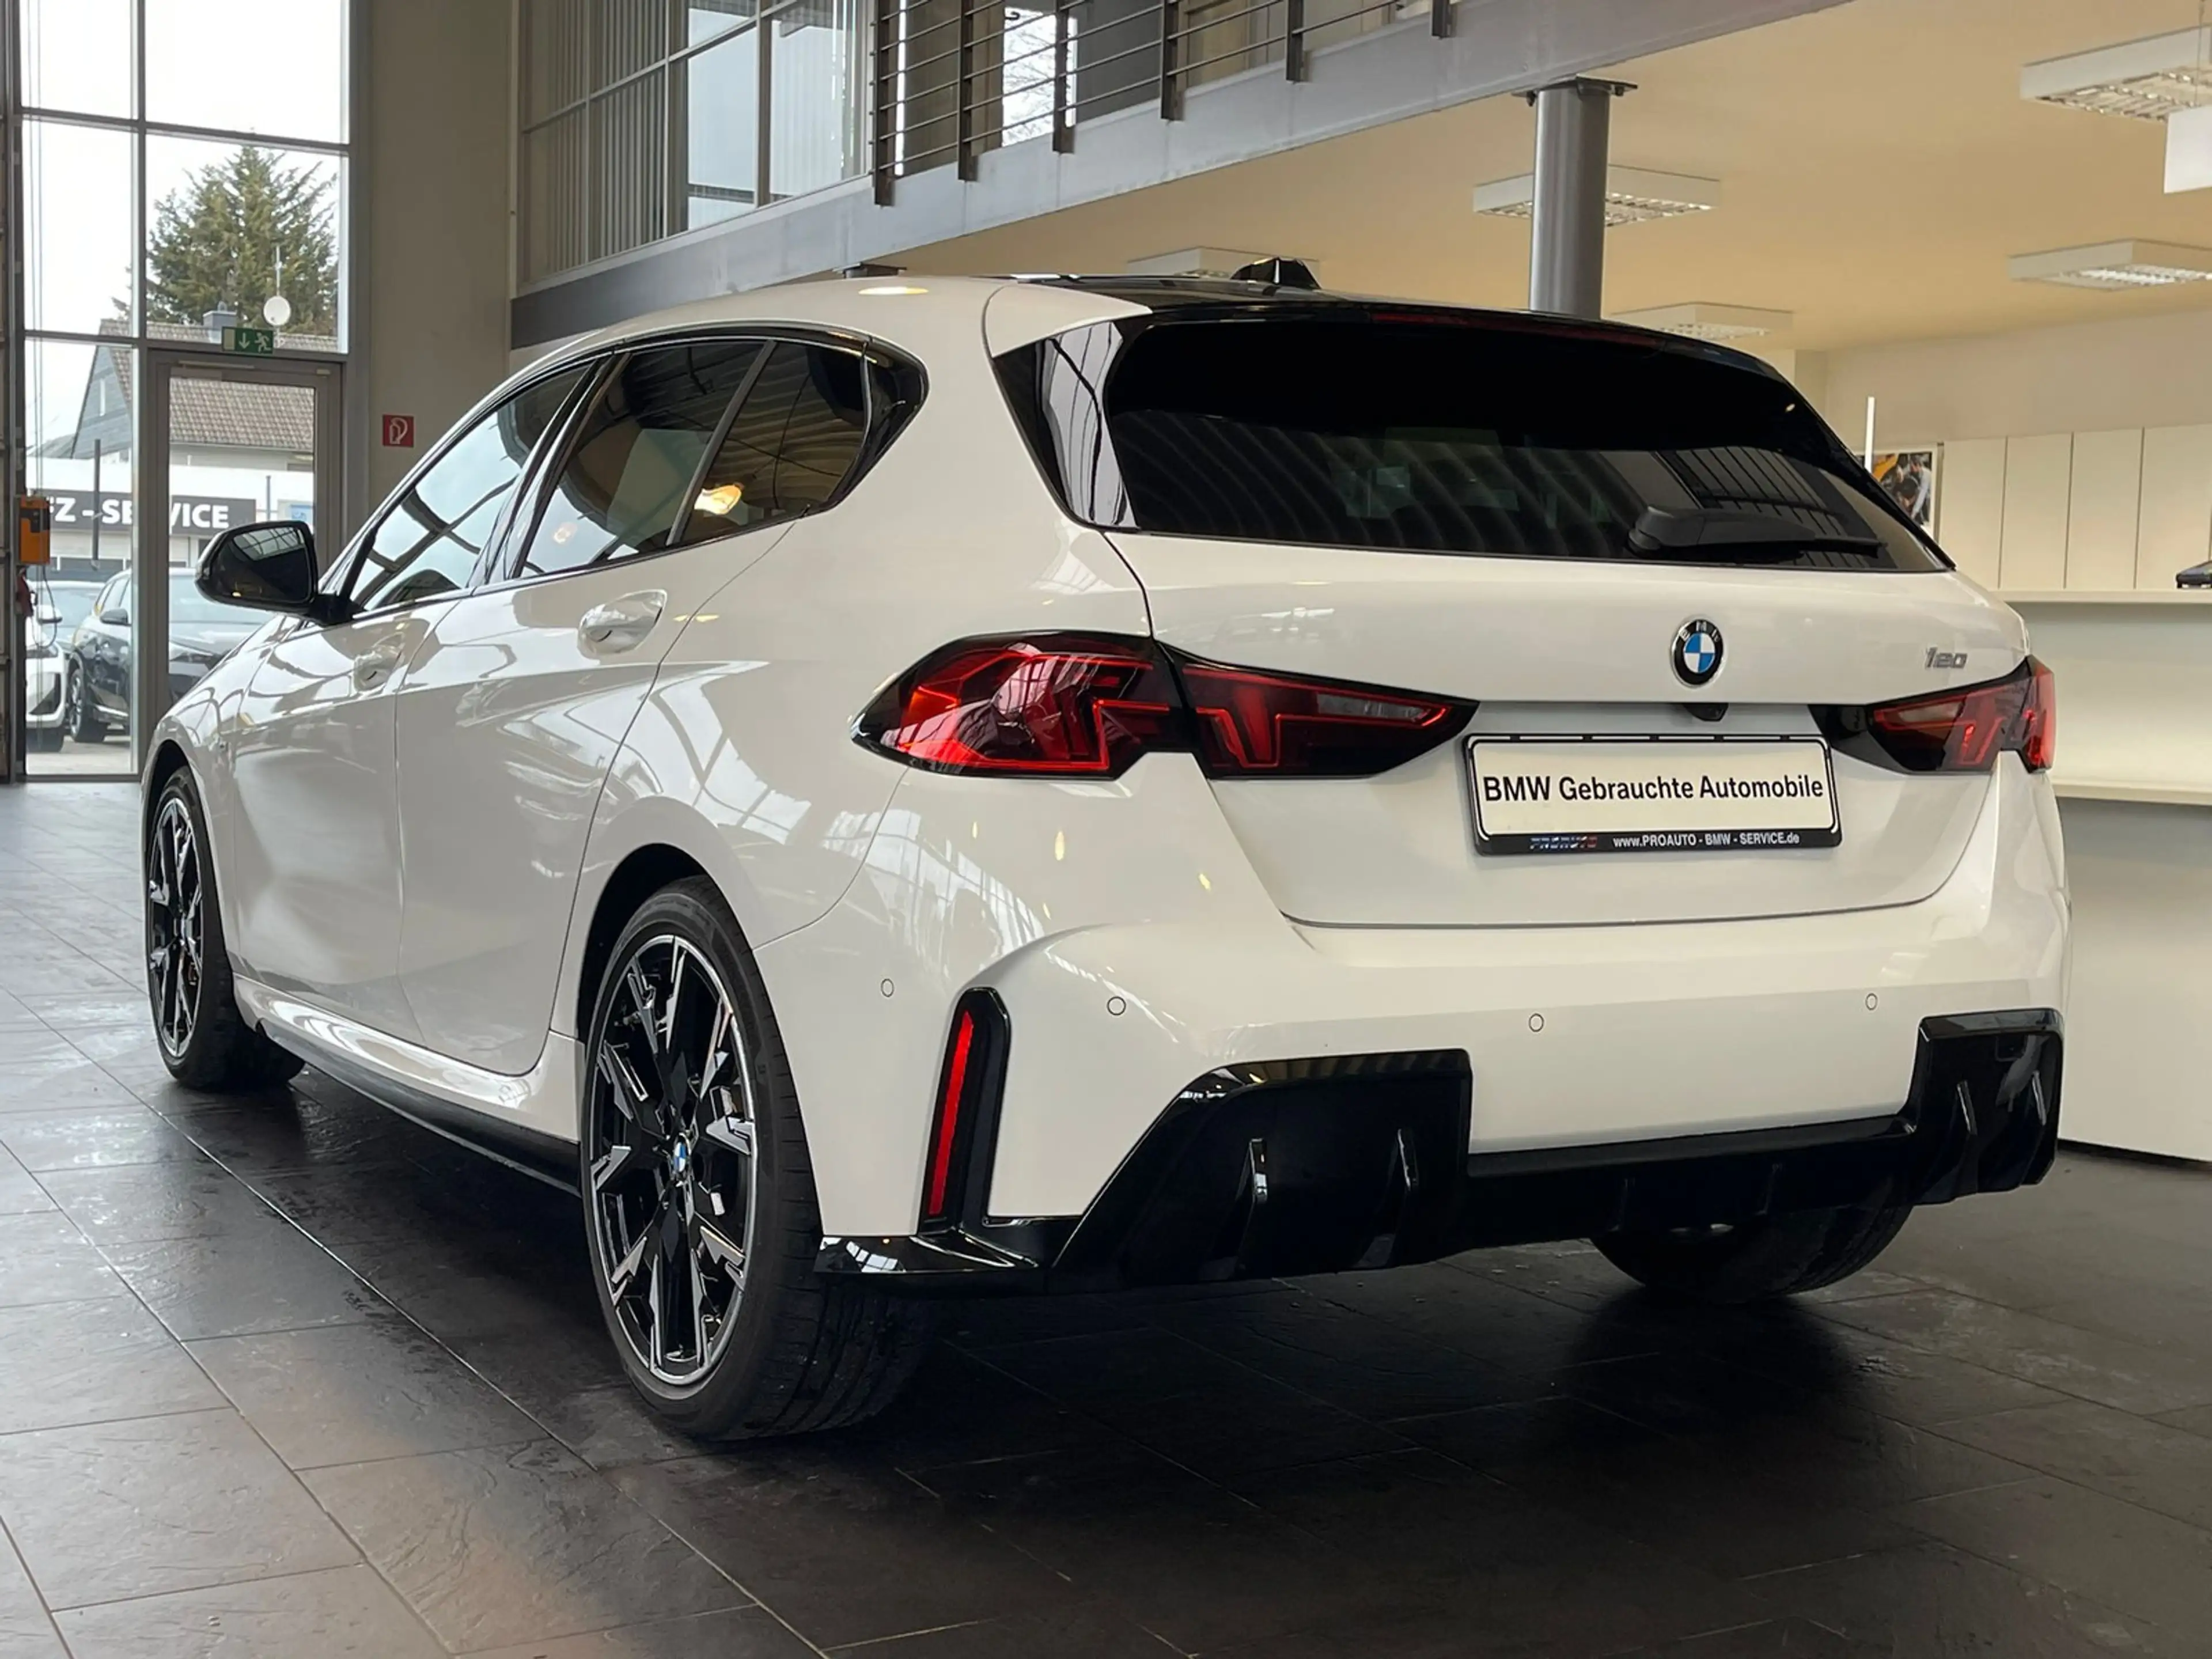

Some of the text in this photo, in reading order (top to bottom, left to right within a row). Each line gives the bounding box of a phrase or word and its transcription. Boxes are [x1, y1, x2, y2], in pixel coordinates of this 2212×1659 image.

[102, 499, 229, 528] SEVICE
[1925, 646, 1968, 668] 120
[1483, 775, 1823, 801] BMW Gebrauchte Automobile
[1706, 834, 1730, 846] BMW
[1740, 832, 1800, 846] SERVICE.de
